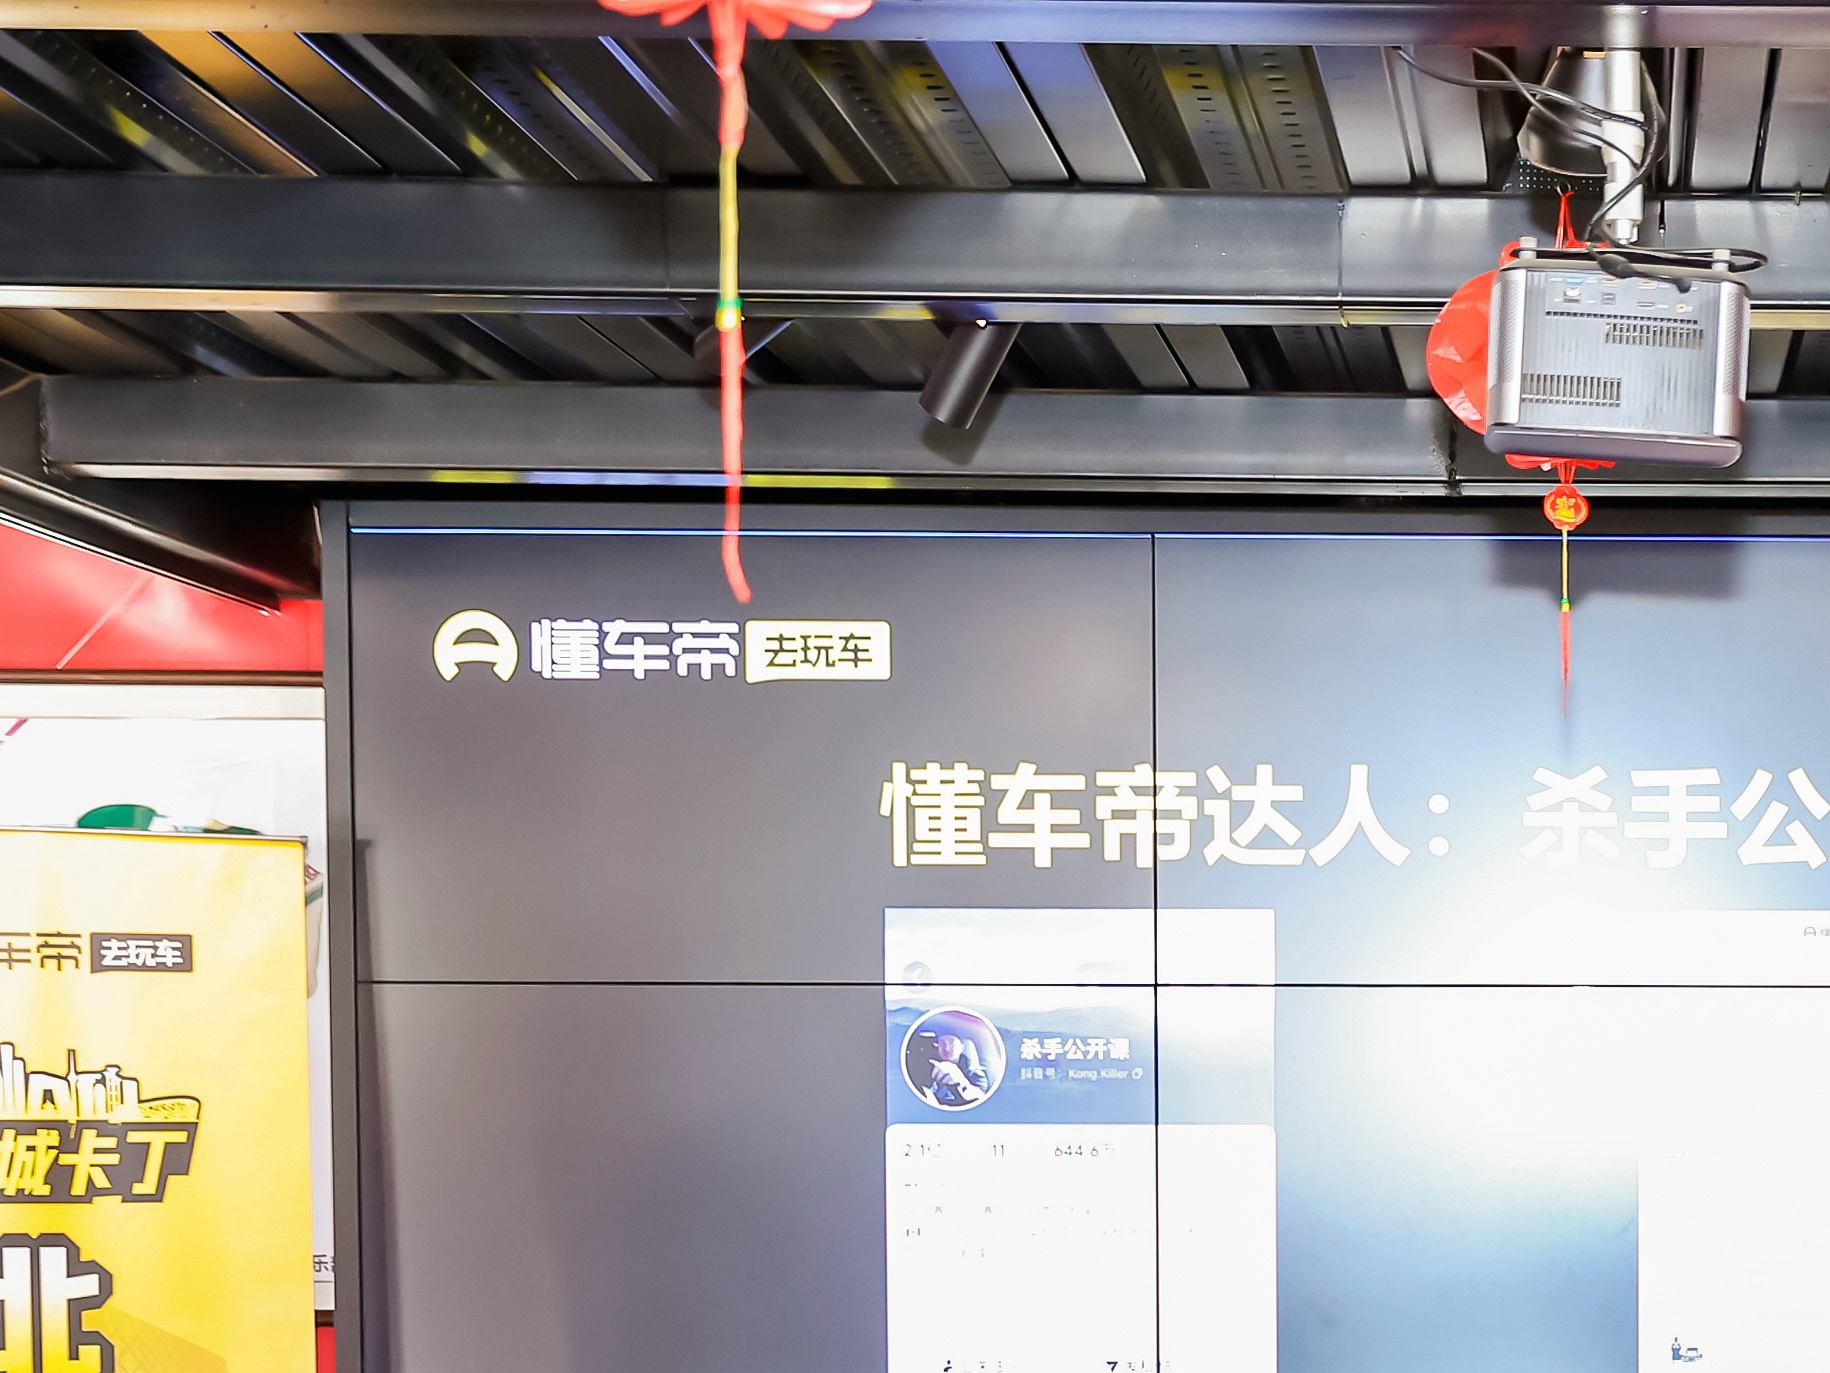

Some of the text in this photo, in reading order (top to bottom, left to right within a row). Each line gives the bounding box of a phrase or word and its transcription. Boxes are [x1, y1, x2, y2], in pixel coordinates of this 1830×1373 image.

[529, 618, 874, 680] 懂车帝 去玩车
[0, 931, 184, 972] 车帝 去玩车
[1020, 1037, 1130, 1060] 杀手公开课
